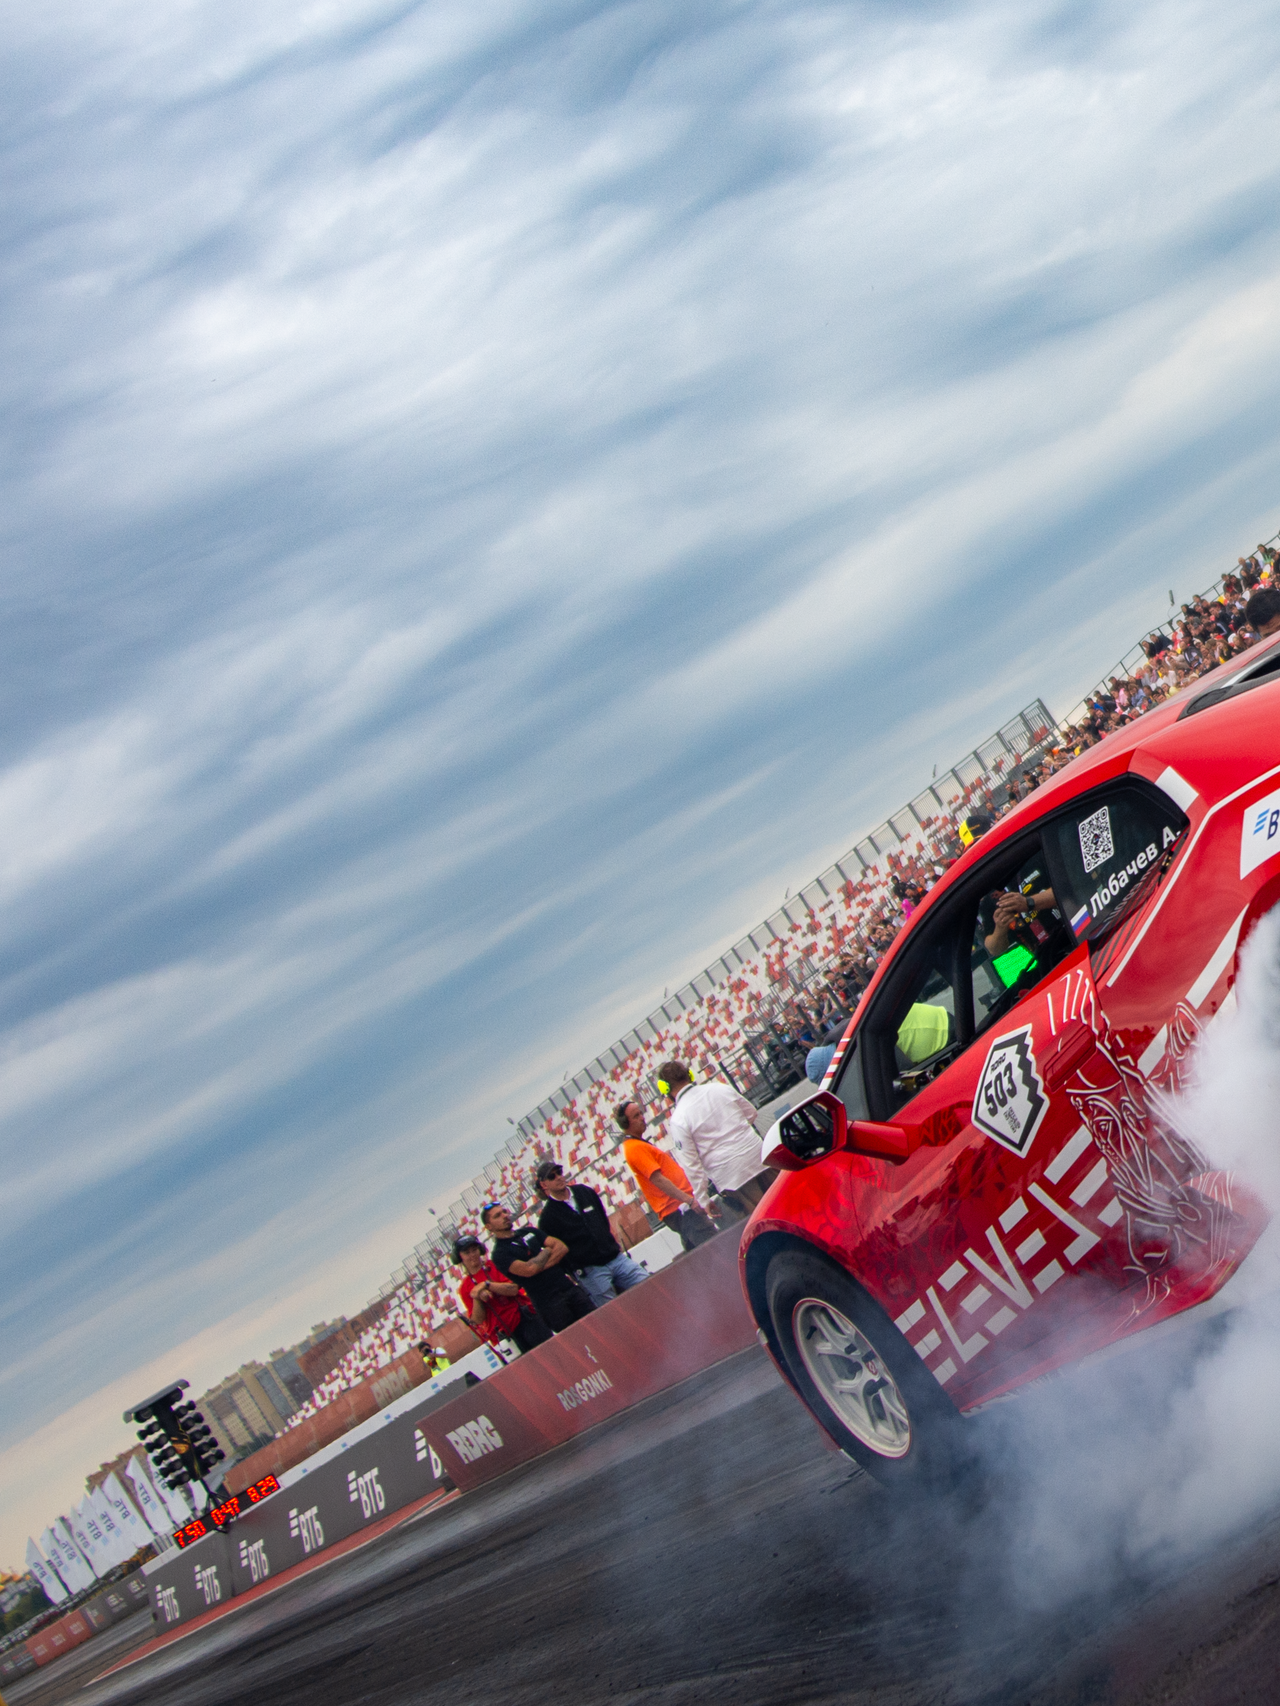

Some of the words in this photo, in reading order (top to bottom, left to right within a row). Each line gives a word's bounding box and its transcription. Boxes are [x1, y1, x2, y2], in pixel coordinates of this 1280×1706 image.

[1089, 843, 1159, 918] Лобачев
[983, 1061, 1018, 1118] 503
[556, 1368, 614, 1412] ROSGONKI
[246, 1474, 279, 1502] 8.29
[357, 1467, 386, 1519] ВТБ
[298, 1505, 325, 1553] ВТБ
[248, 1538, 269, 1583] ВТБ
